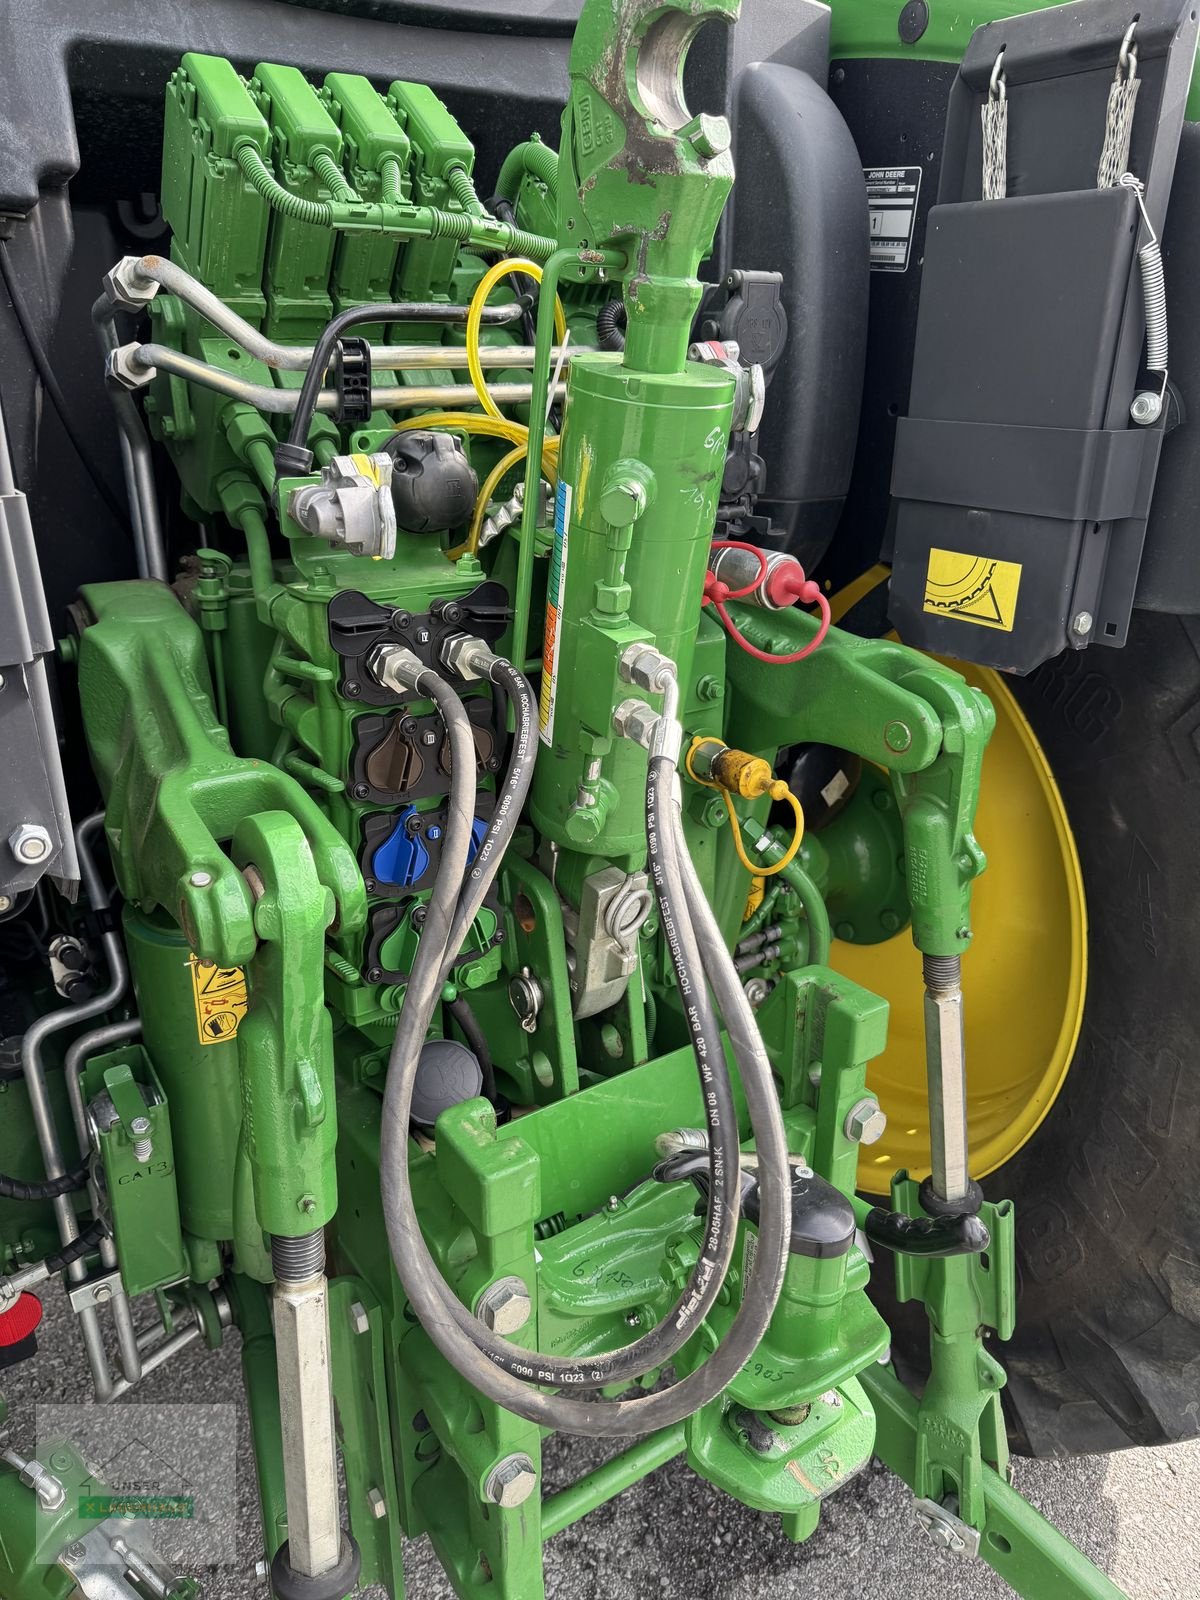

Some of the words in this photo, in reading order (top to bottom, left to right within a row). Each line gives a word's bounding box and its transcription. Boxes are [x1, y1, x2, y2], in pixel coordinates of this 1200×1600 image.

[885, 170, 904, 178] DEERE
[872, 217, 877, 229] 1
[513, 676, 526, 689] BAR
[516, 693, 530, 760] HOCHABRIEBFEST
[500, 795, 512, 816] 6090
[490, 818, 503, 835] PSI
[480, 839, 494, 862] 1Q23
[650, 831, 658, 855] 6090
[660, 896, 692, 995] HOCHABRIEBFEST
[688, 1005, 702, 1032] BAR
[697, 1038, 707, 1058] 420
[702, 1064, 712, 1084] WP
[707, 1092, 716, 1106] 08
[710, 1109, 720, 1126] DN
[538, 1371, 554, 1382] PSI
[560, 1373, 584, 1382] 1Q23
